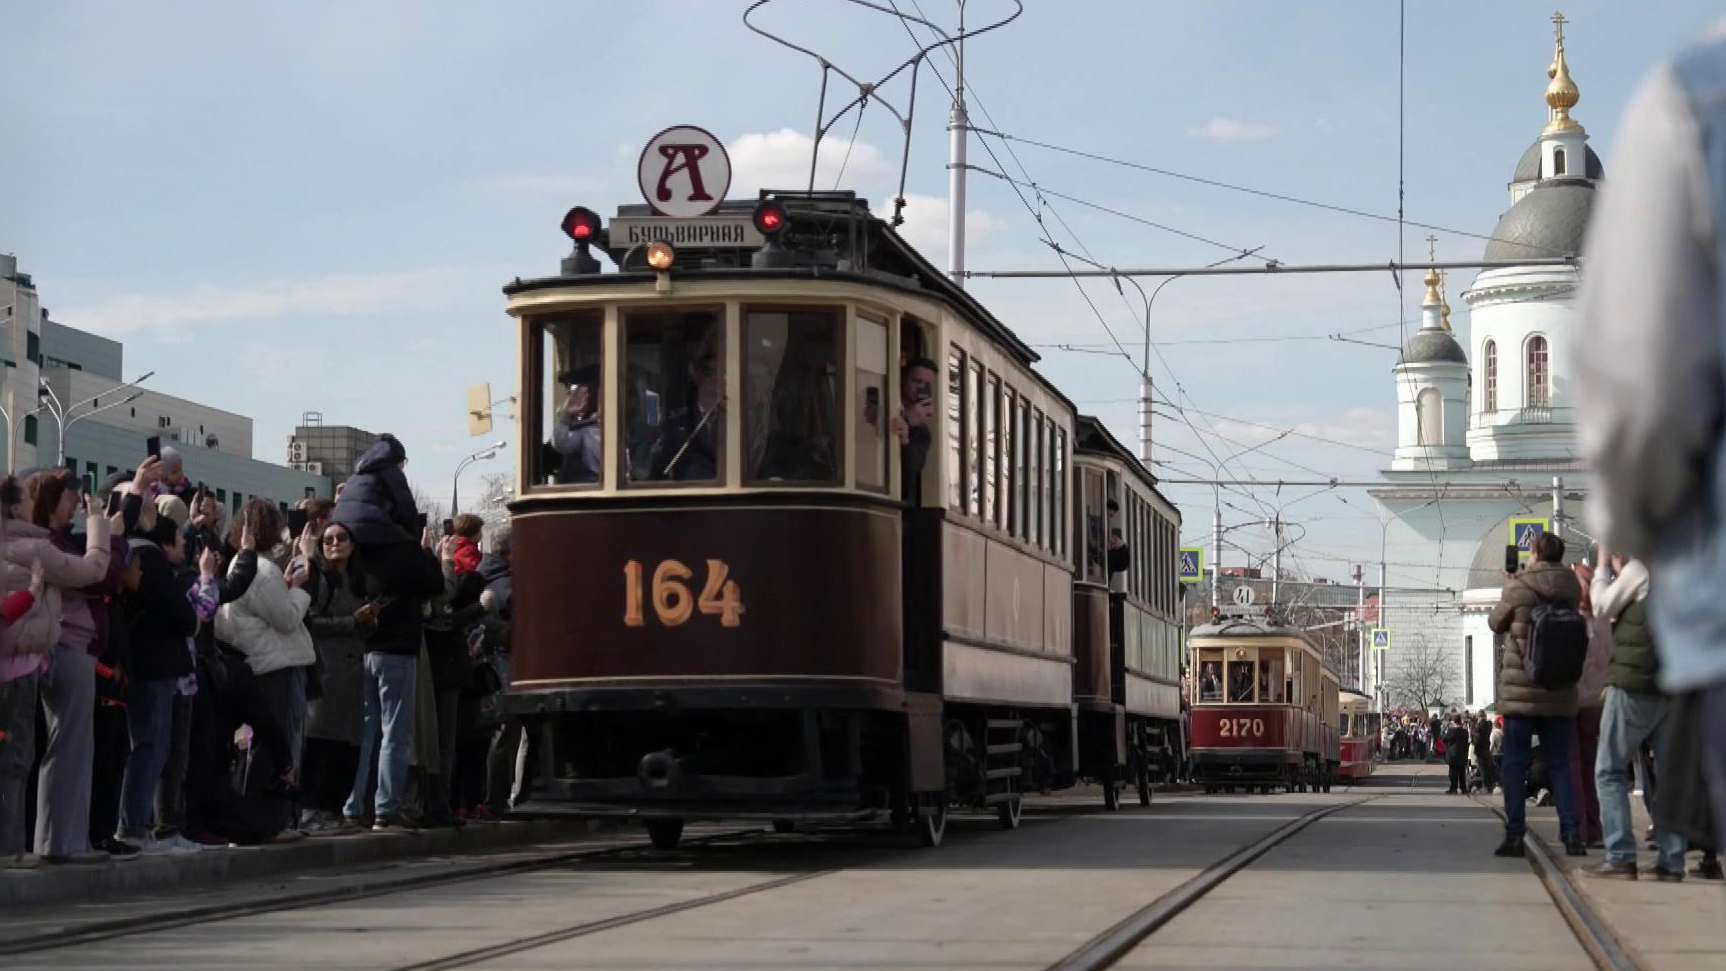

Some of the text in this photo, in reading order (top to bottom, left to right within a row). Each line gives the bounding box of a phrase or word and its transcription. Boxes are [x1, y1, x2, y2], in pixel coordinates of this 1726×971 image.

[656, 144, 713, 202] А
[629, 224, 745, 243] БУЛЬВАРНАЯ
[623, 559, 746, 627] 164
[1236, 588, 1250, 604] 41
[1219, 718, 1265, 737] 2170
